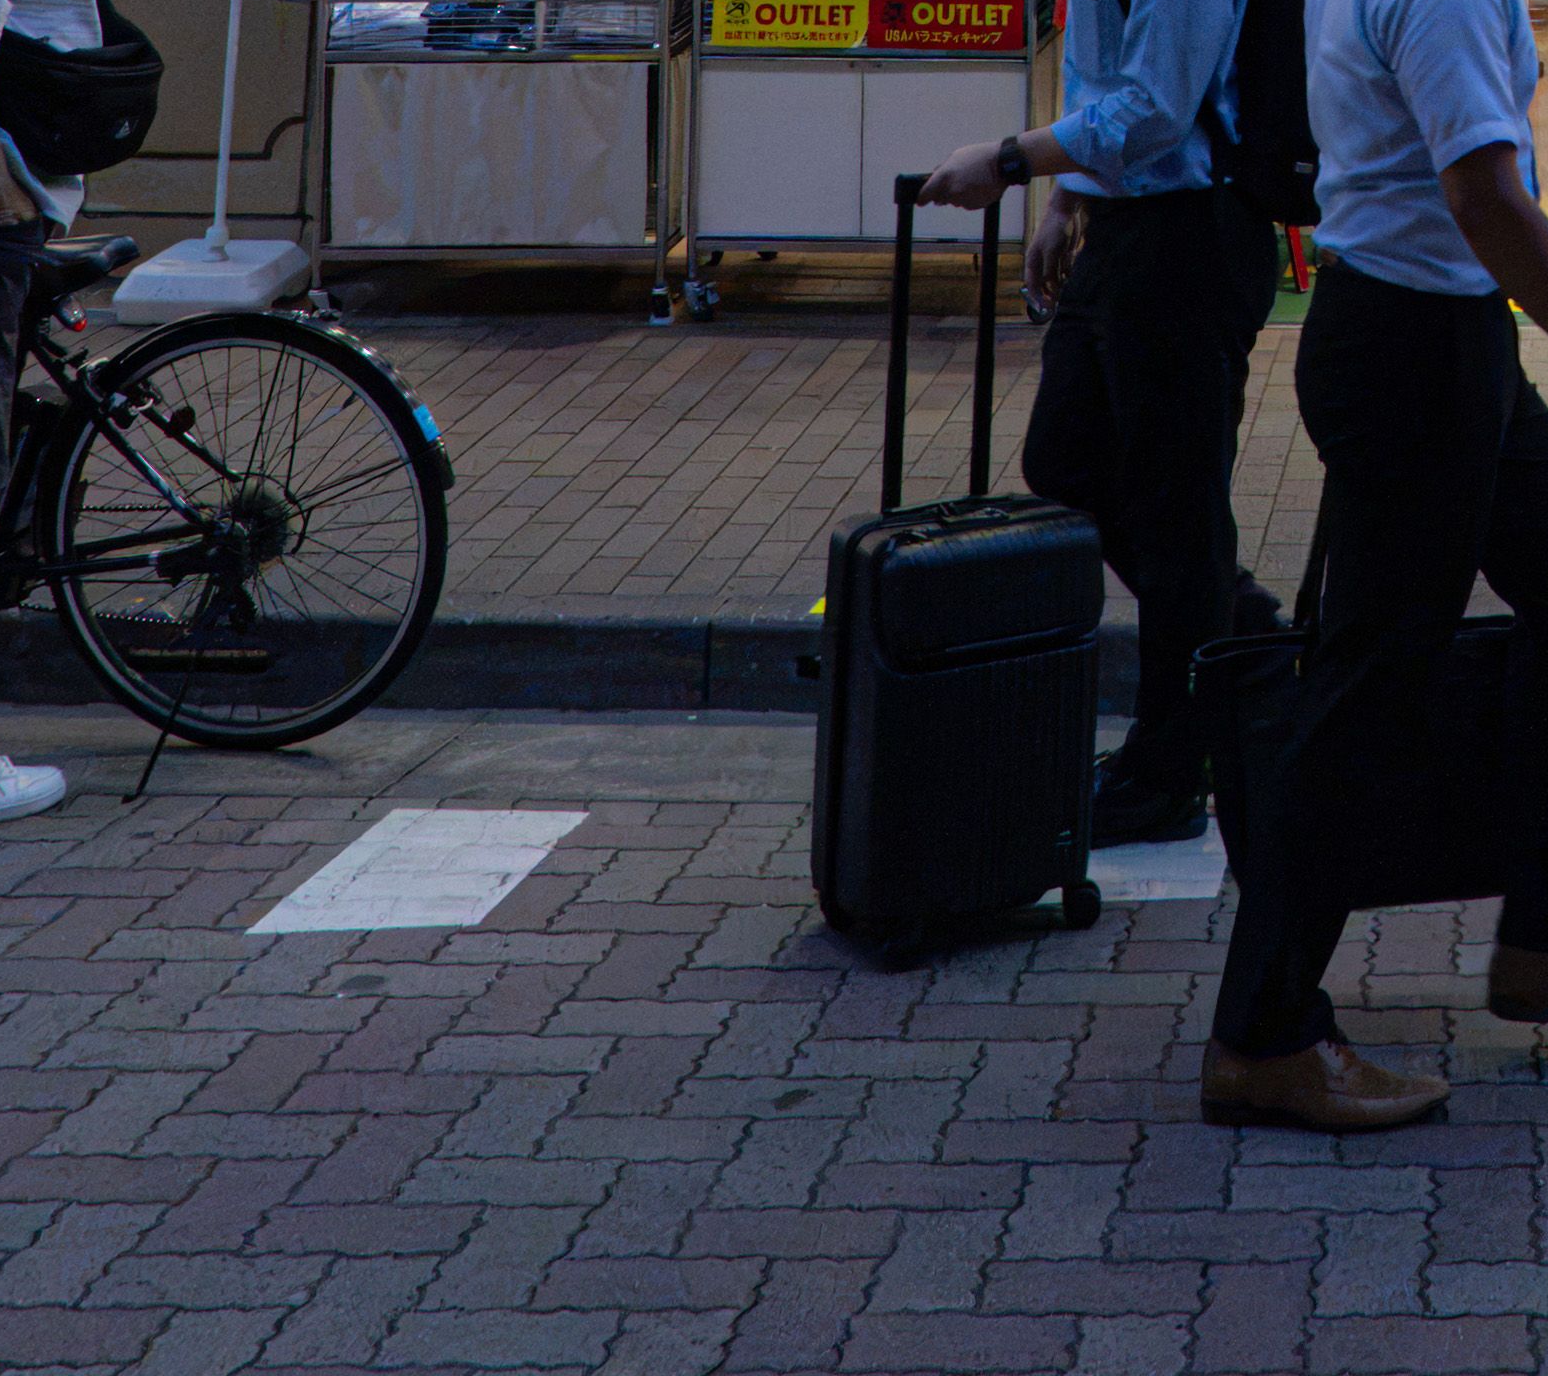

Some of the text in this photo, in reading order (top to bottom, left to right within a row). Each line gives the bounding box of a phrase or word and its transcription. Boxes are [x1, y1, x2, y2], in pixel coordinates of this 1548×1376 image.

[755, 3, 856, 26] OUTLET
[911, 1, 1014, 27] OUTLET
[884, 30, 1002, 44] USAバラエティキャップ
